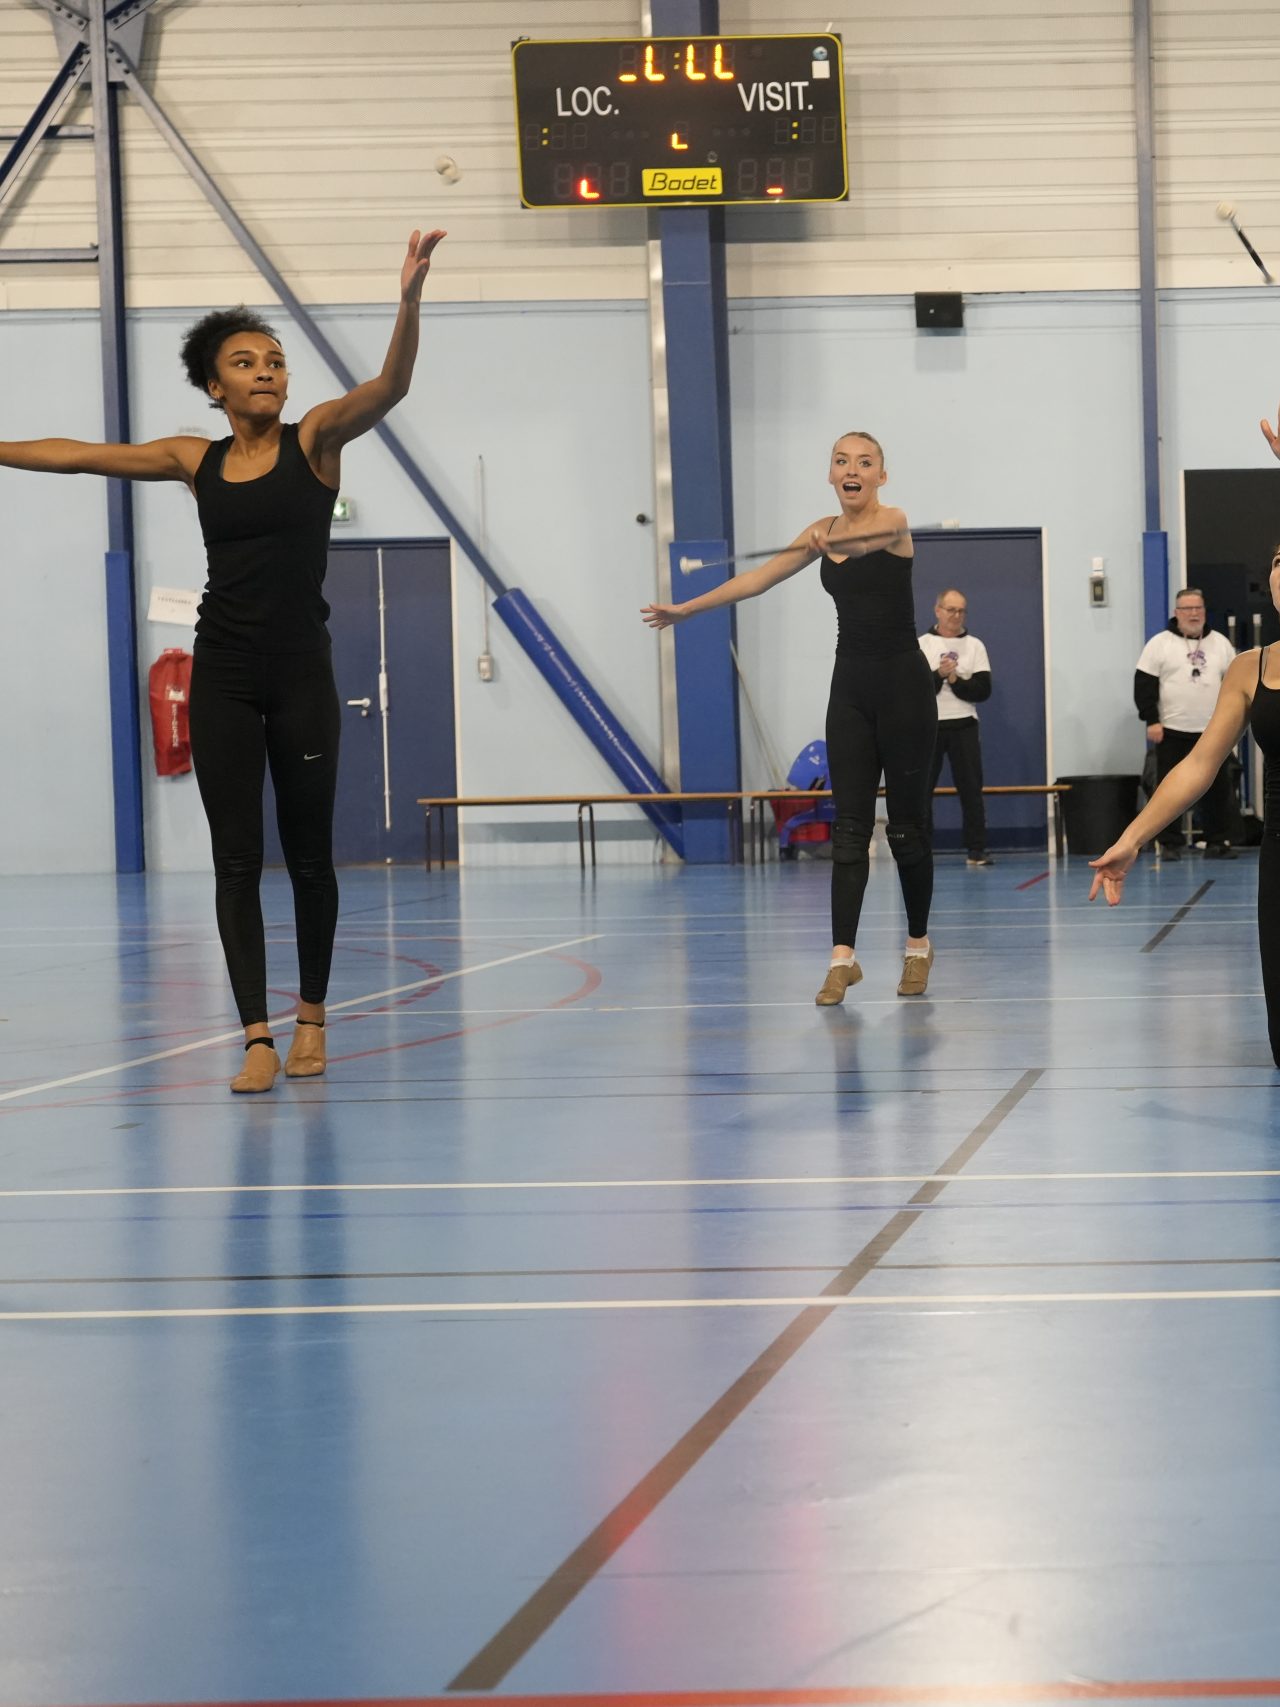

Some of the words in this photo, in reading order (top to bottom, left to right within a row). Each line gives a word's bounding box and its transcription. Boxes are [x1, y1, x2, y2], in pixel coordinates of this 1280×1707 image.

[556, 86, 620, 117] LOC.
[737, 81, 814, 112] VISIT.
[648, 172, 718, 191] Bodet
